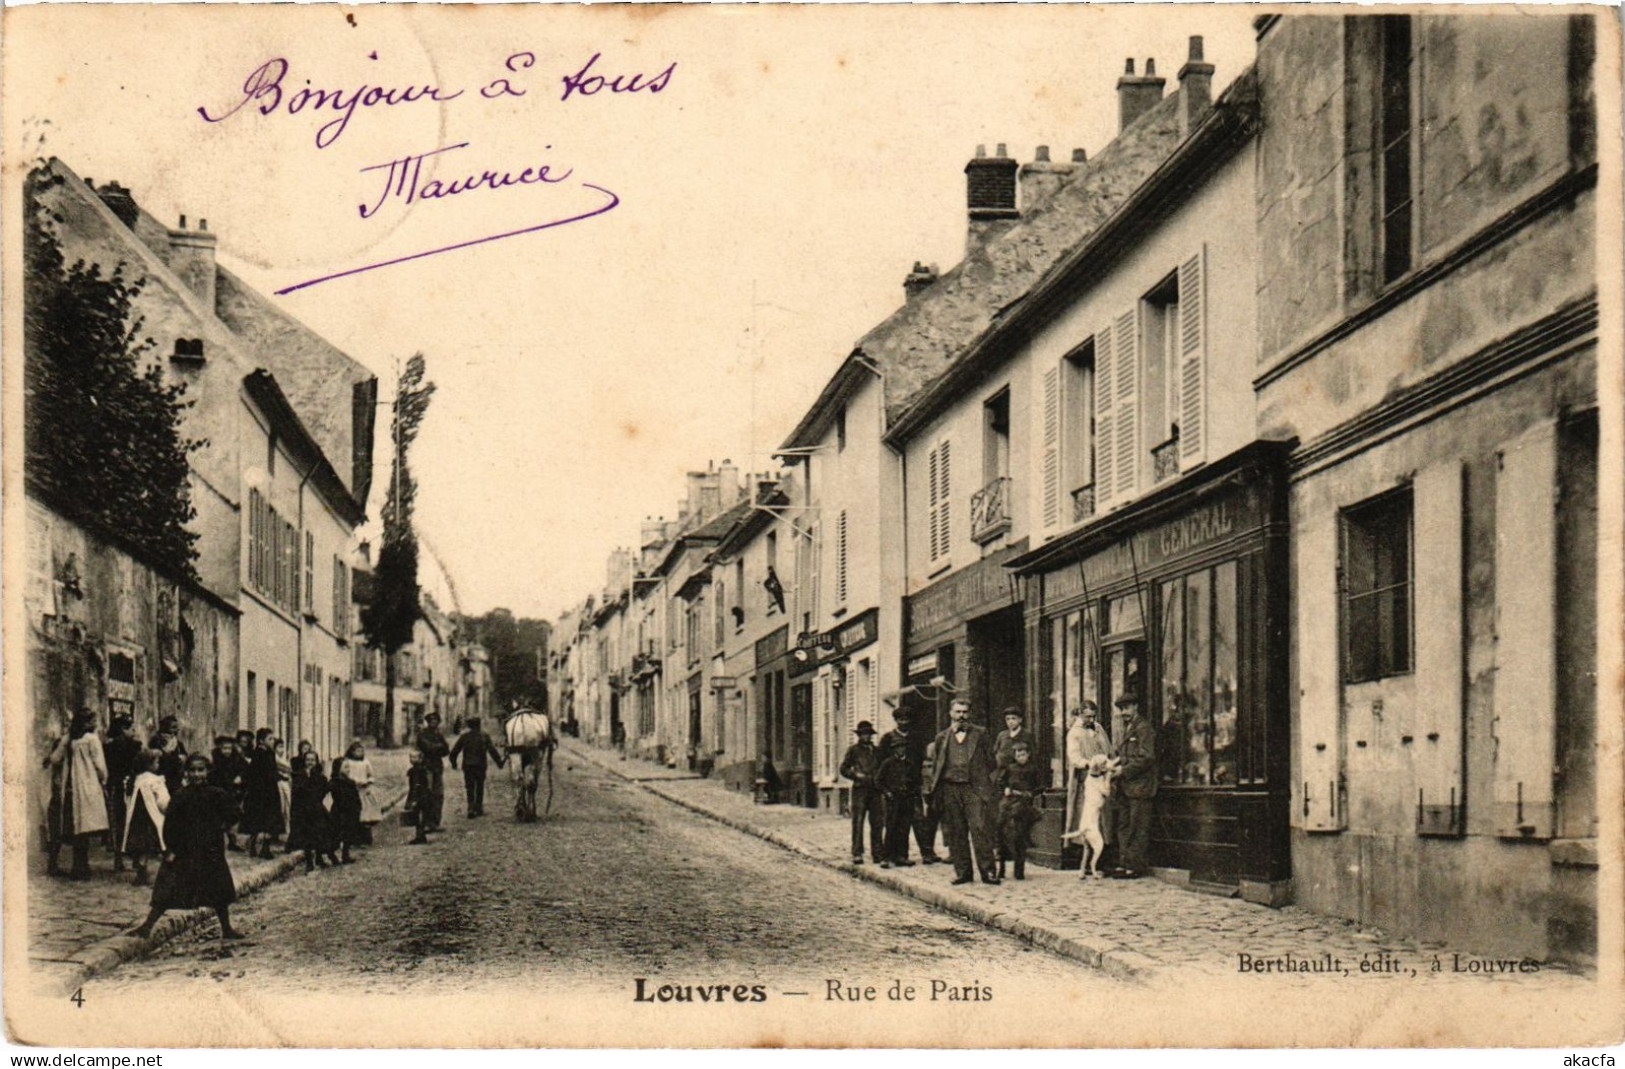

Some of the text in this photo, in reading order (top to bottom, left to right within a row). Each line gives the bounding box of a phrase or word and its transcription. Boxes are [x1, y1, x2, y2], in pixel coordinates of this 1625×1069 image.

[198, 50, 464, 149] Bonjour
[562, 52, 677, 101] tous
[359, 143, 573, 218] Maurice
